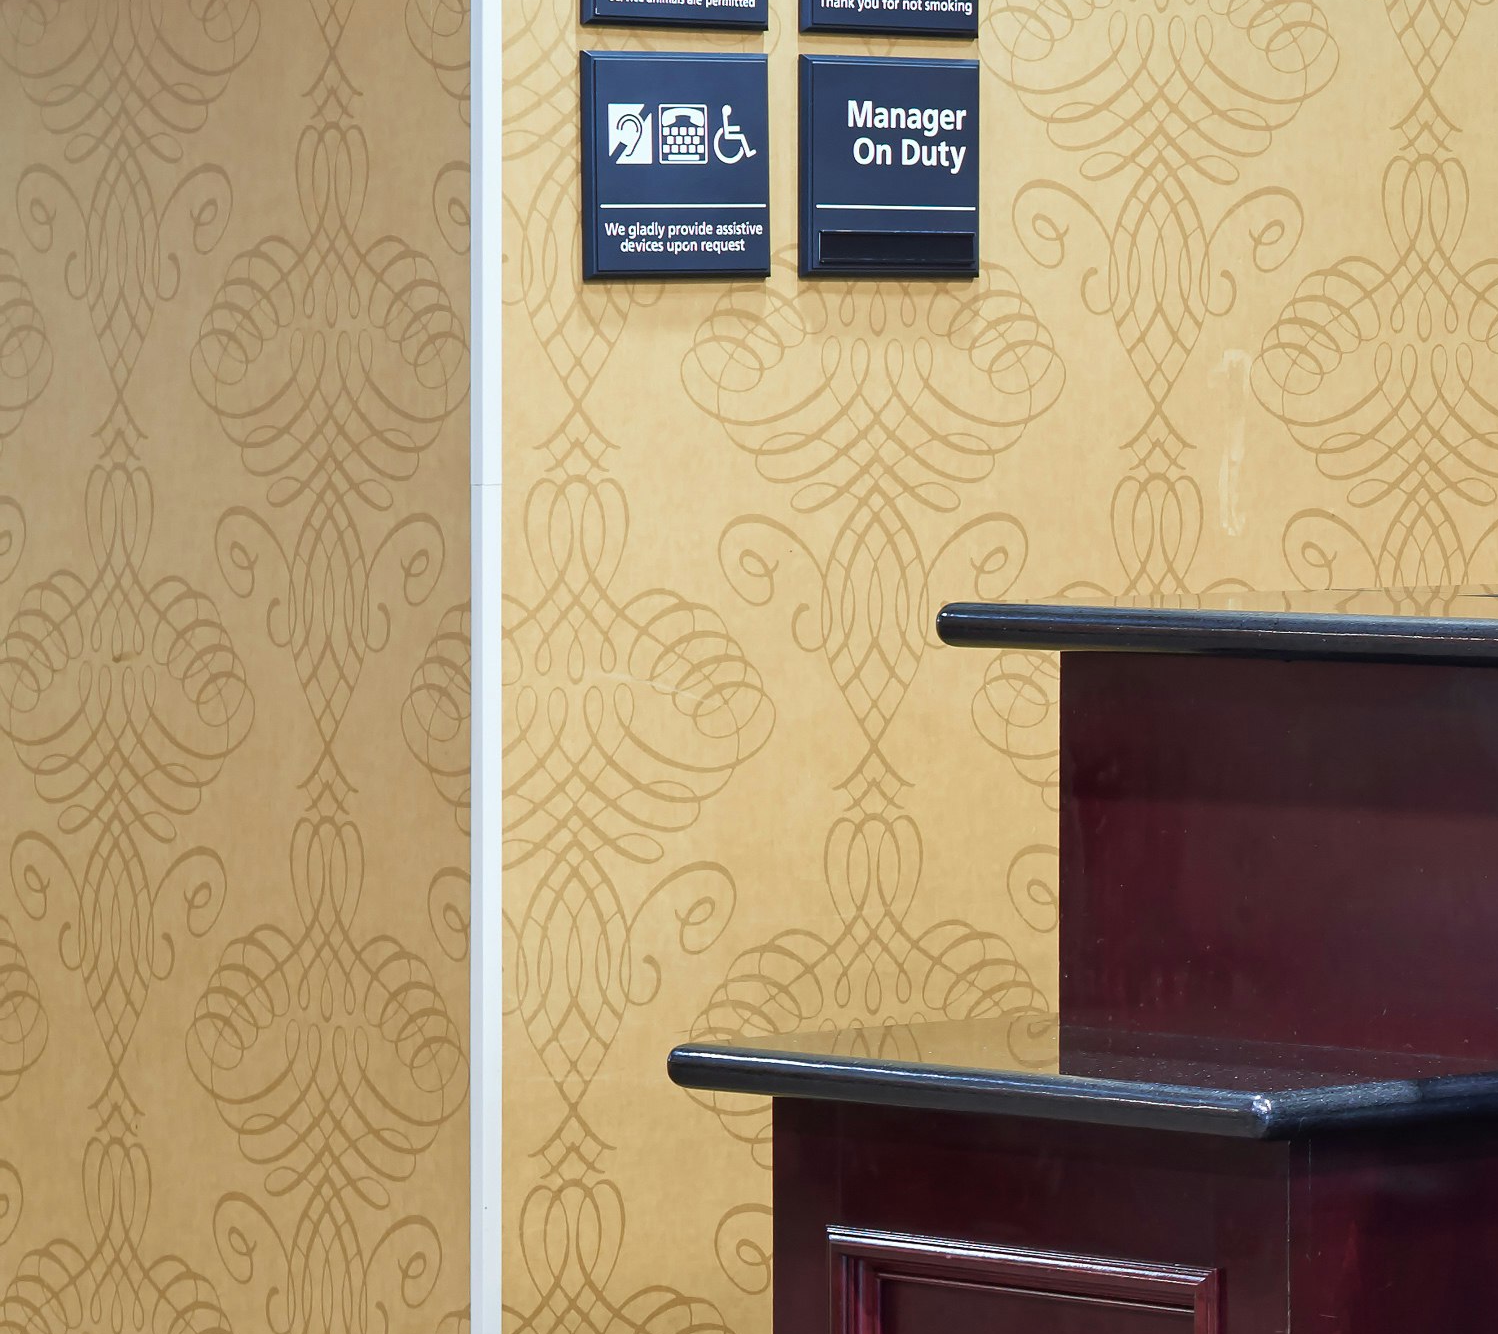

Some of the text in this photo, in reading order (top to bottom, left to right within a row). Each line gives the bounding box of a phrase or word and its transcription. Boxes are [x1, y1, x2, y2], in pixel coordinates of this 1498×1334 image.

[857, 0, 879, 12] you
[848, 100, 967, 137] Manager
[853, 137, 967, 174] On Duty
[605, 222, 763, 239] We gladly provide assistive
[620, 238, 746, 255] devices upon request
